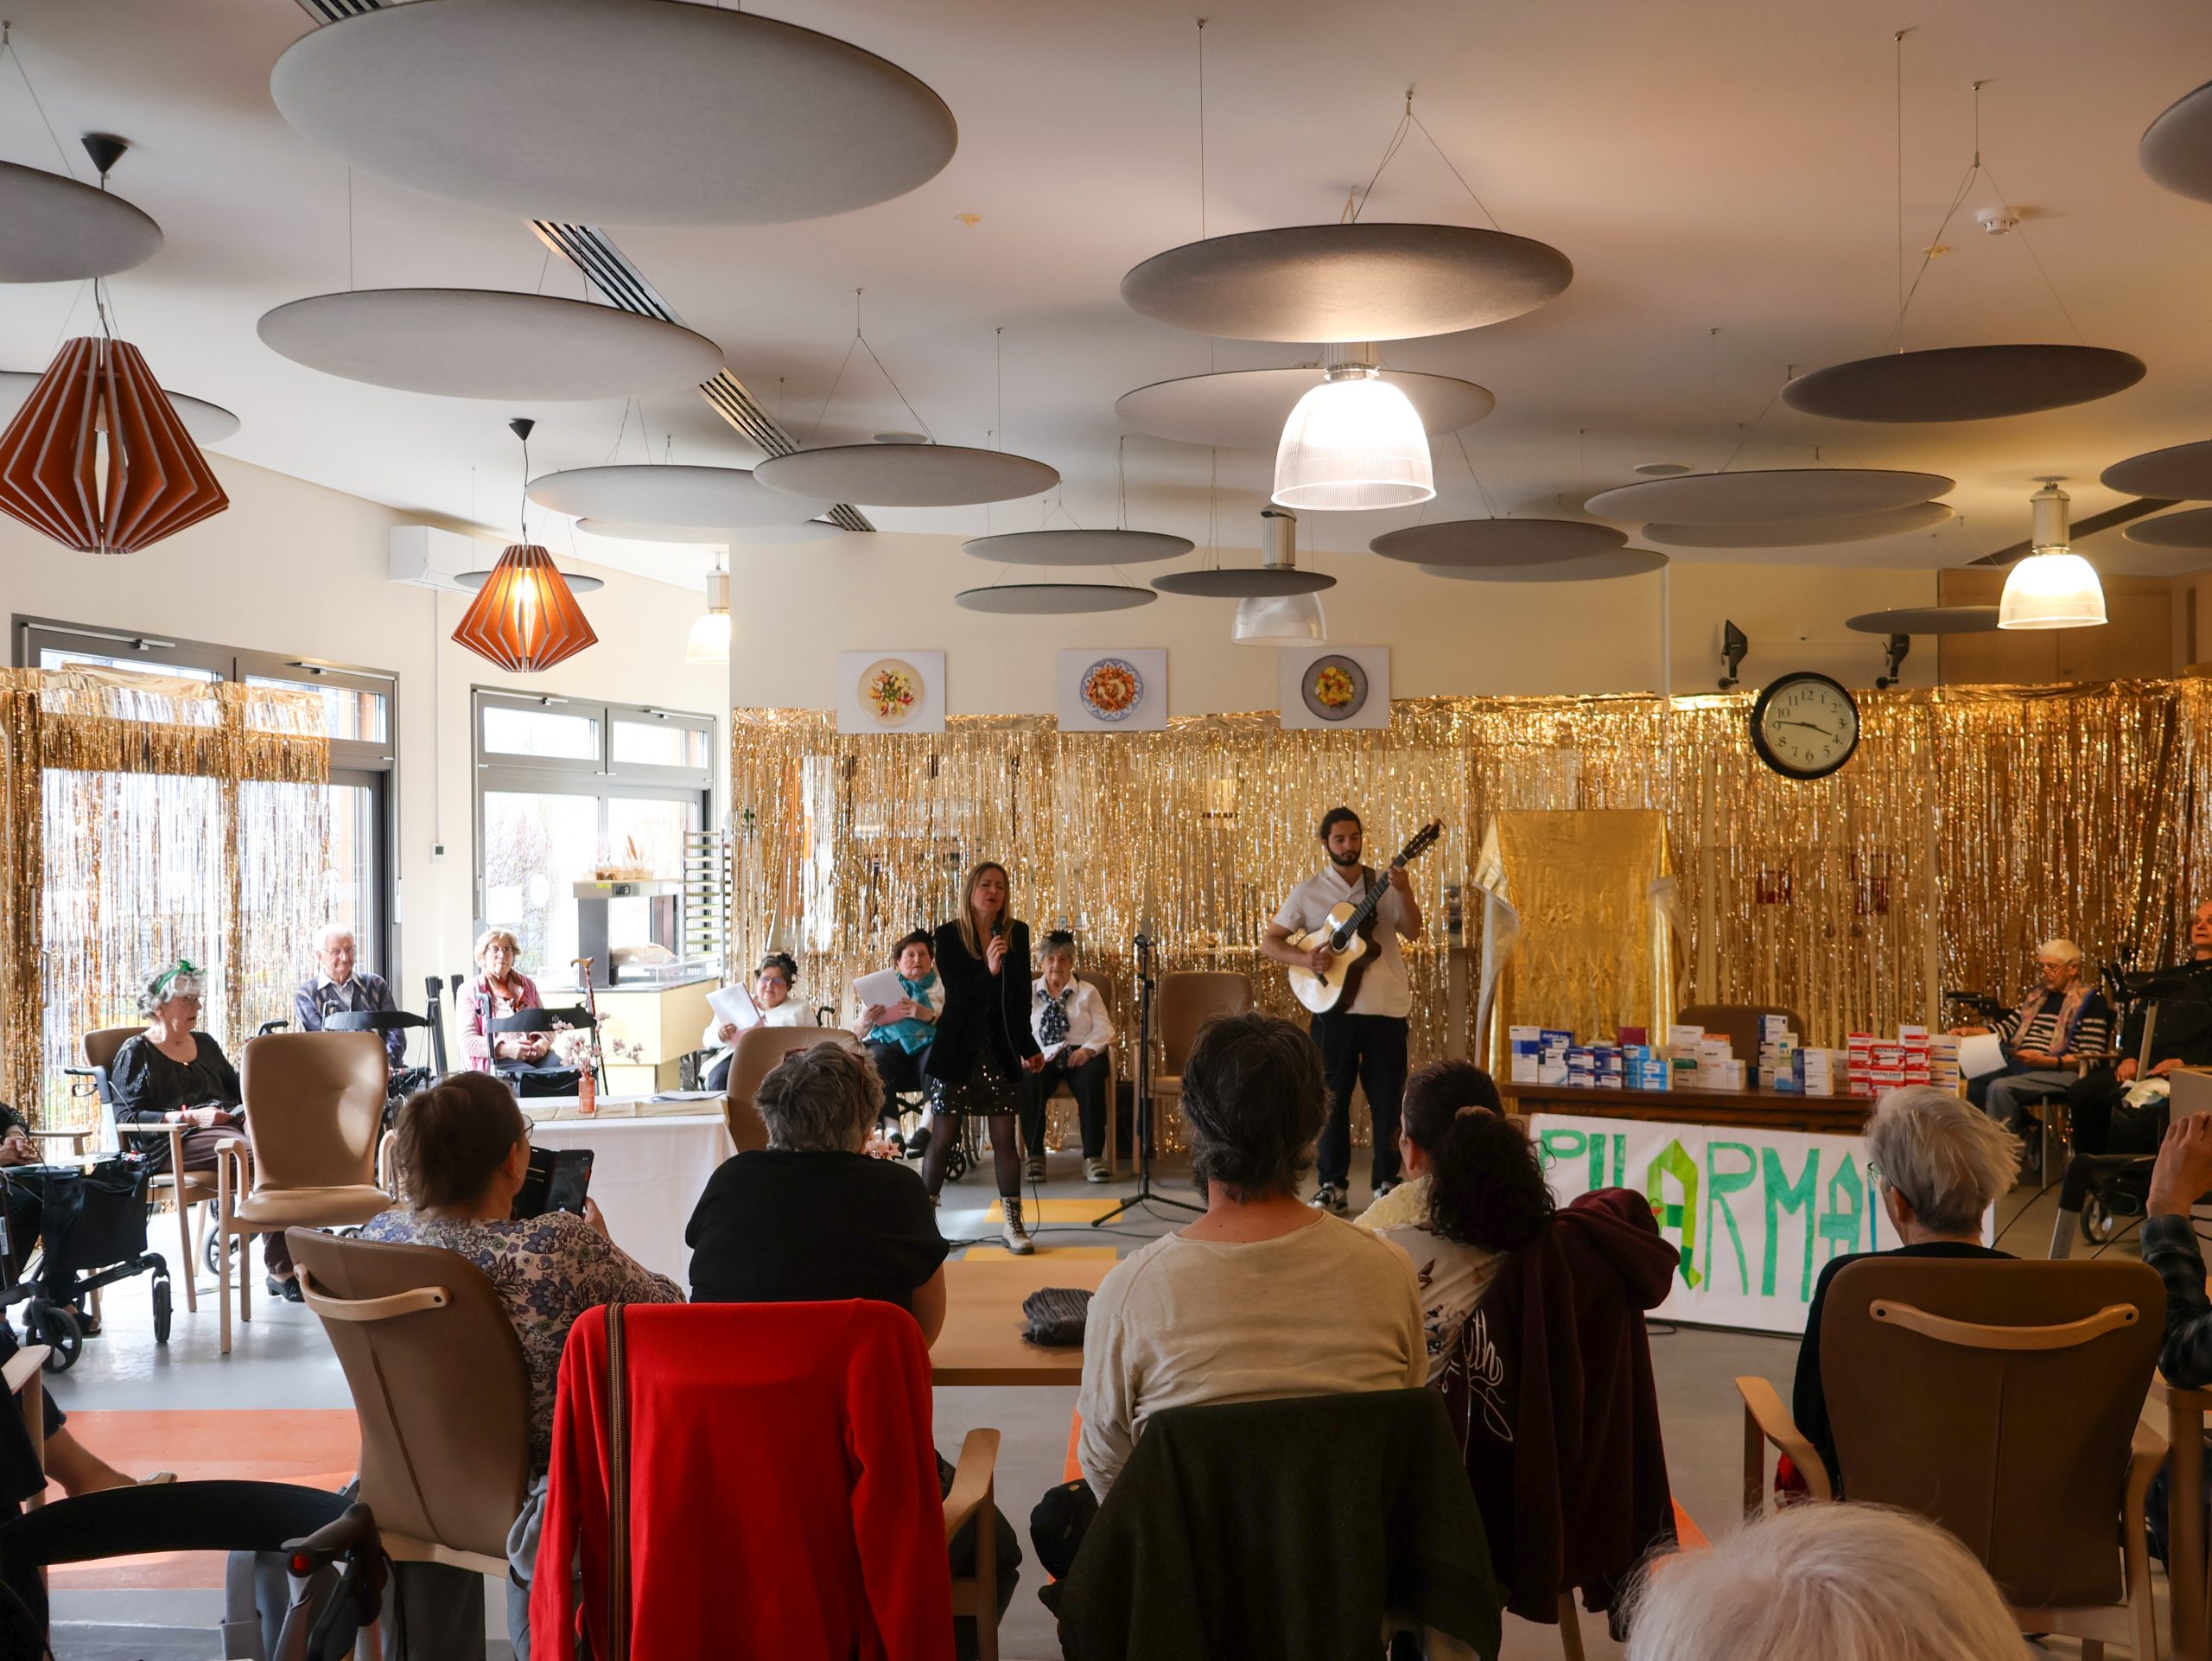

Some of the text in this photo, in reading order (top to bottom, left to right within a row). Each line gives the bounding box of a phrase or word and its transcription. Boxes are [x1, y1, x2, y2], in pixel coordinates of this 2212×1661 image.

[1788, 695, 1798, 706] 11
[1801, 690, 1815, 701] 12
[1777, 707, 1790, 718] 10
[1830, 703, 1838, 713] 2
[1772, 721, 1781, 732] 9
[1838, 718, 1846, 729] 3
[1778, 736, 1787, 748] 8
[1832, 735, 1840, 745] 4
[1791, 747, 1798, 757] 7
[1805, 749, 1815, 761] 6
[1823, 745, 1831, 758] 5
